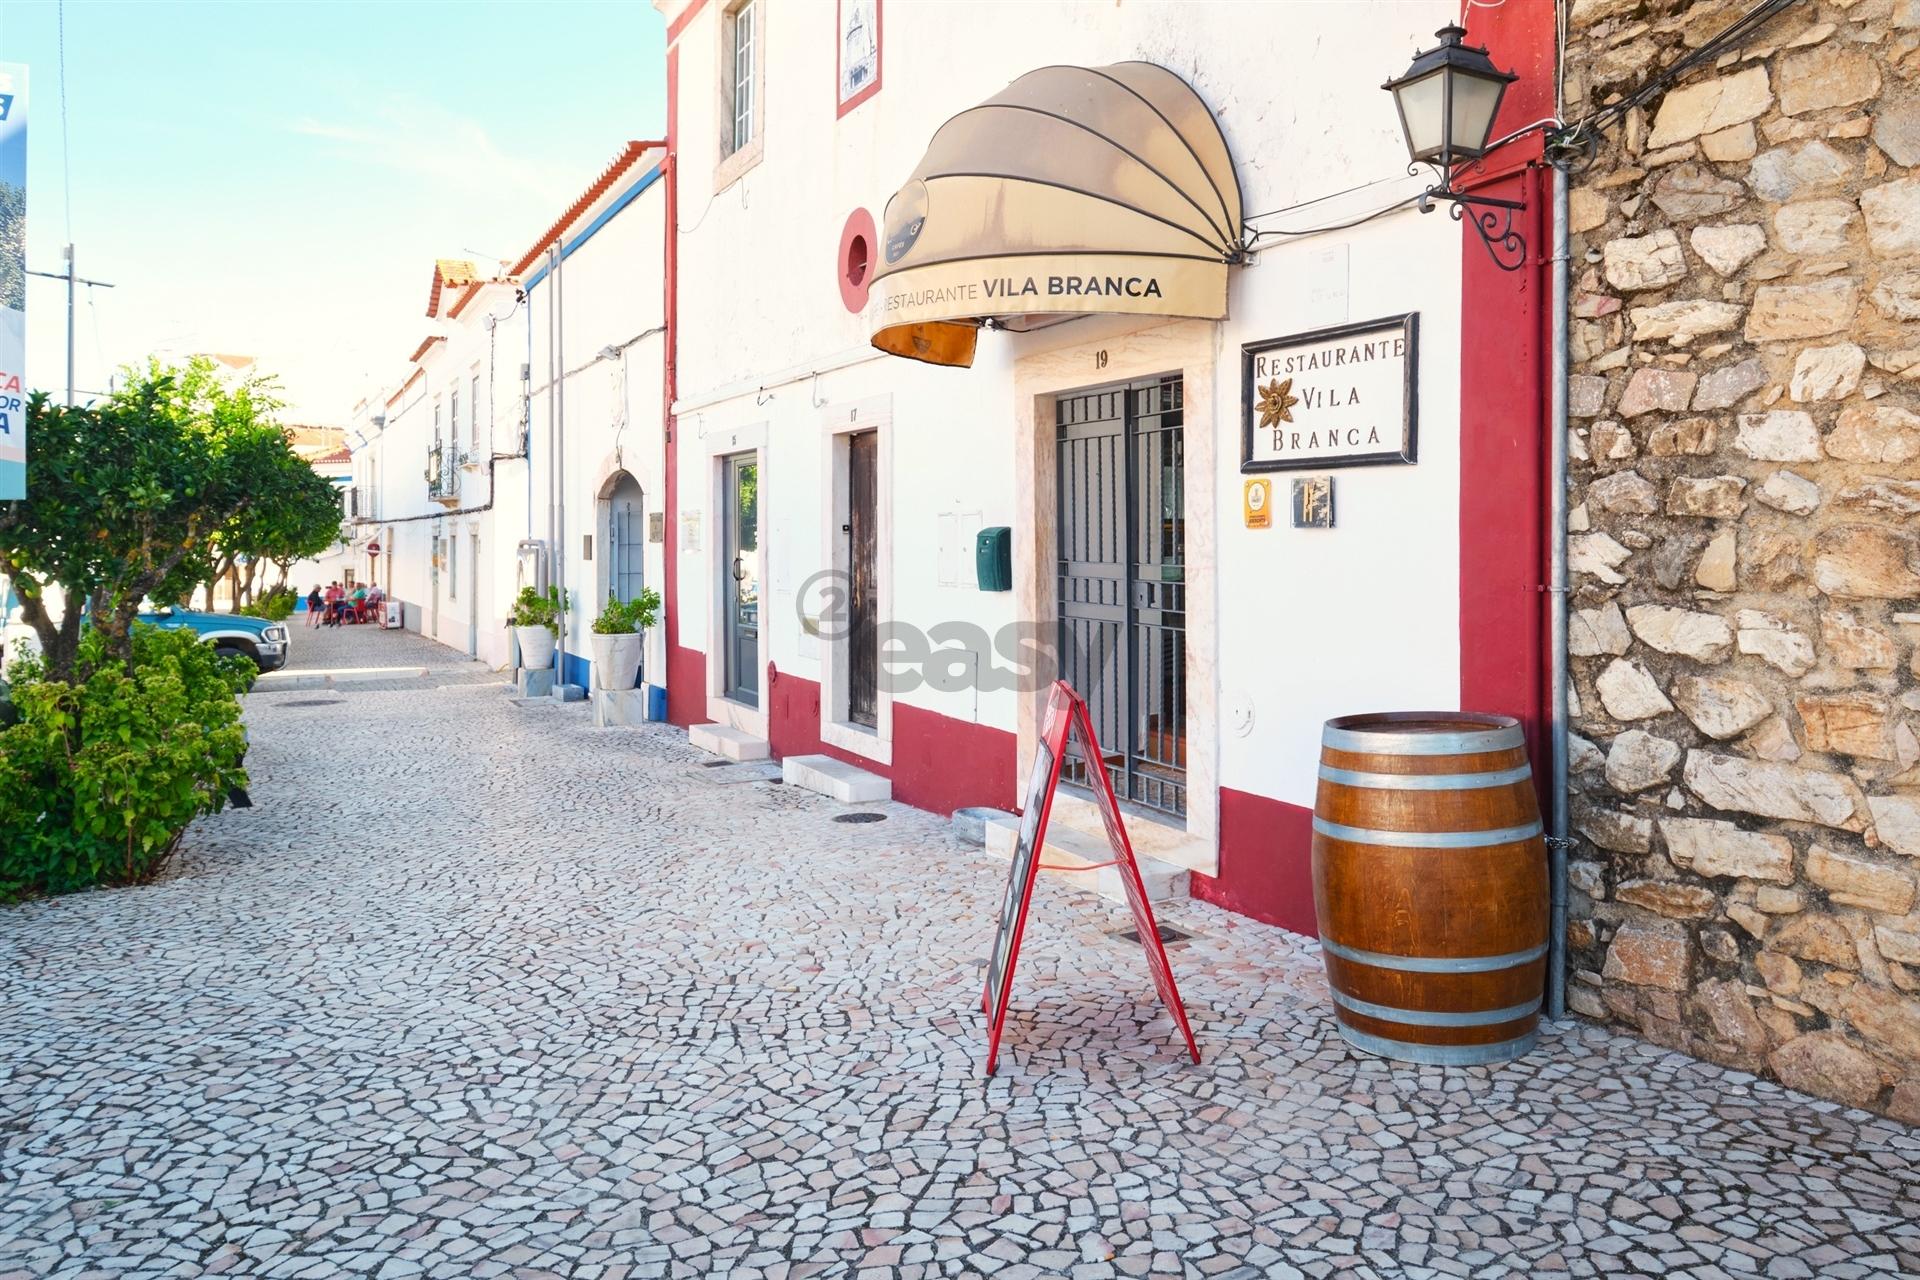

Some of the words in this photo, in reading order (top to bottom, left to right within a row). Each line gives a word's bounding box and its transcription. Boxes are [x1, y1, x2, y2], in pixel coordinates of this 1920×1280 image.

[983, 277, 1039, 298] VILA
[1047, 276, 1163, 298] BRANCA
[1096, 350, 1108, 370] 19
[1256, 338, 1405, 378] RESTAURANTE
[1302, 387, 1361, 410] VILA
[850, 408, 857, 423] 17
[1273, 426, 1381, 451] BRANCA
